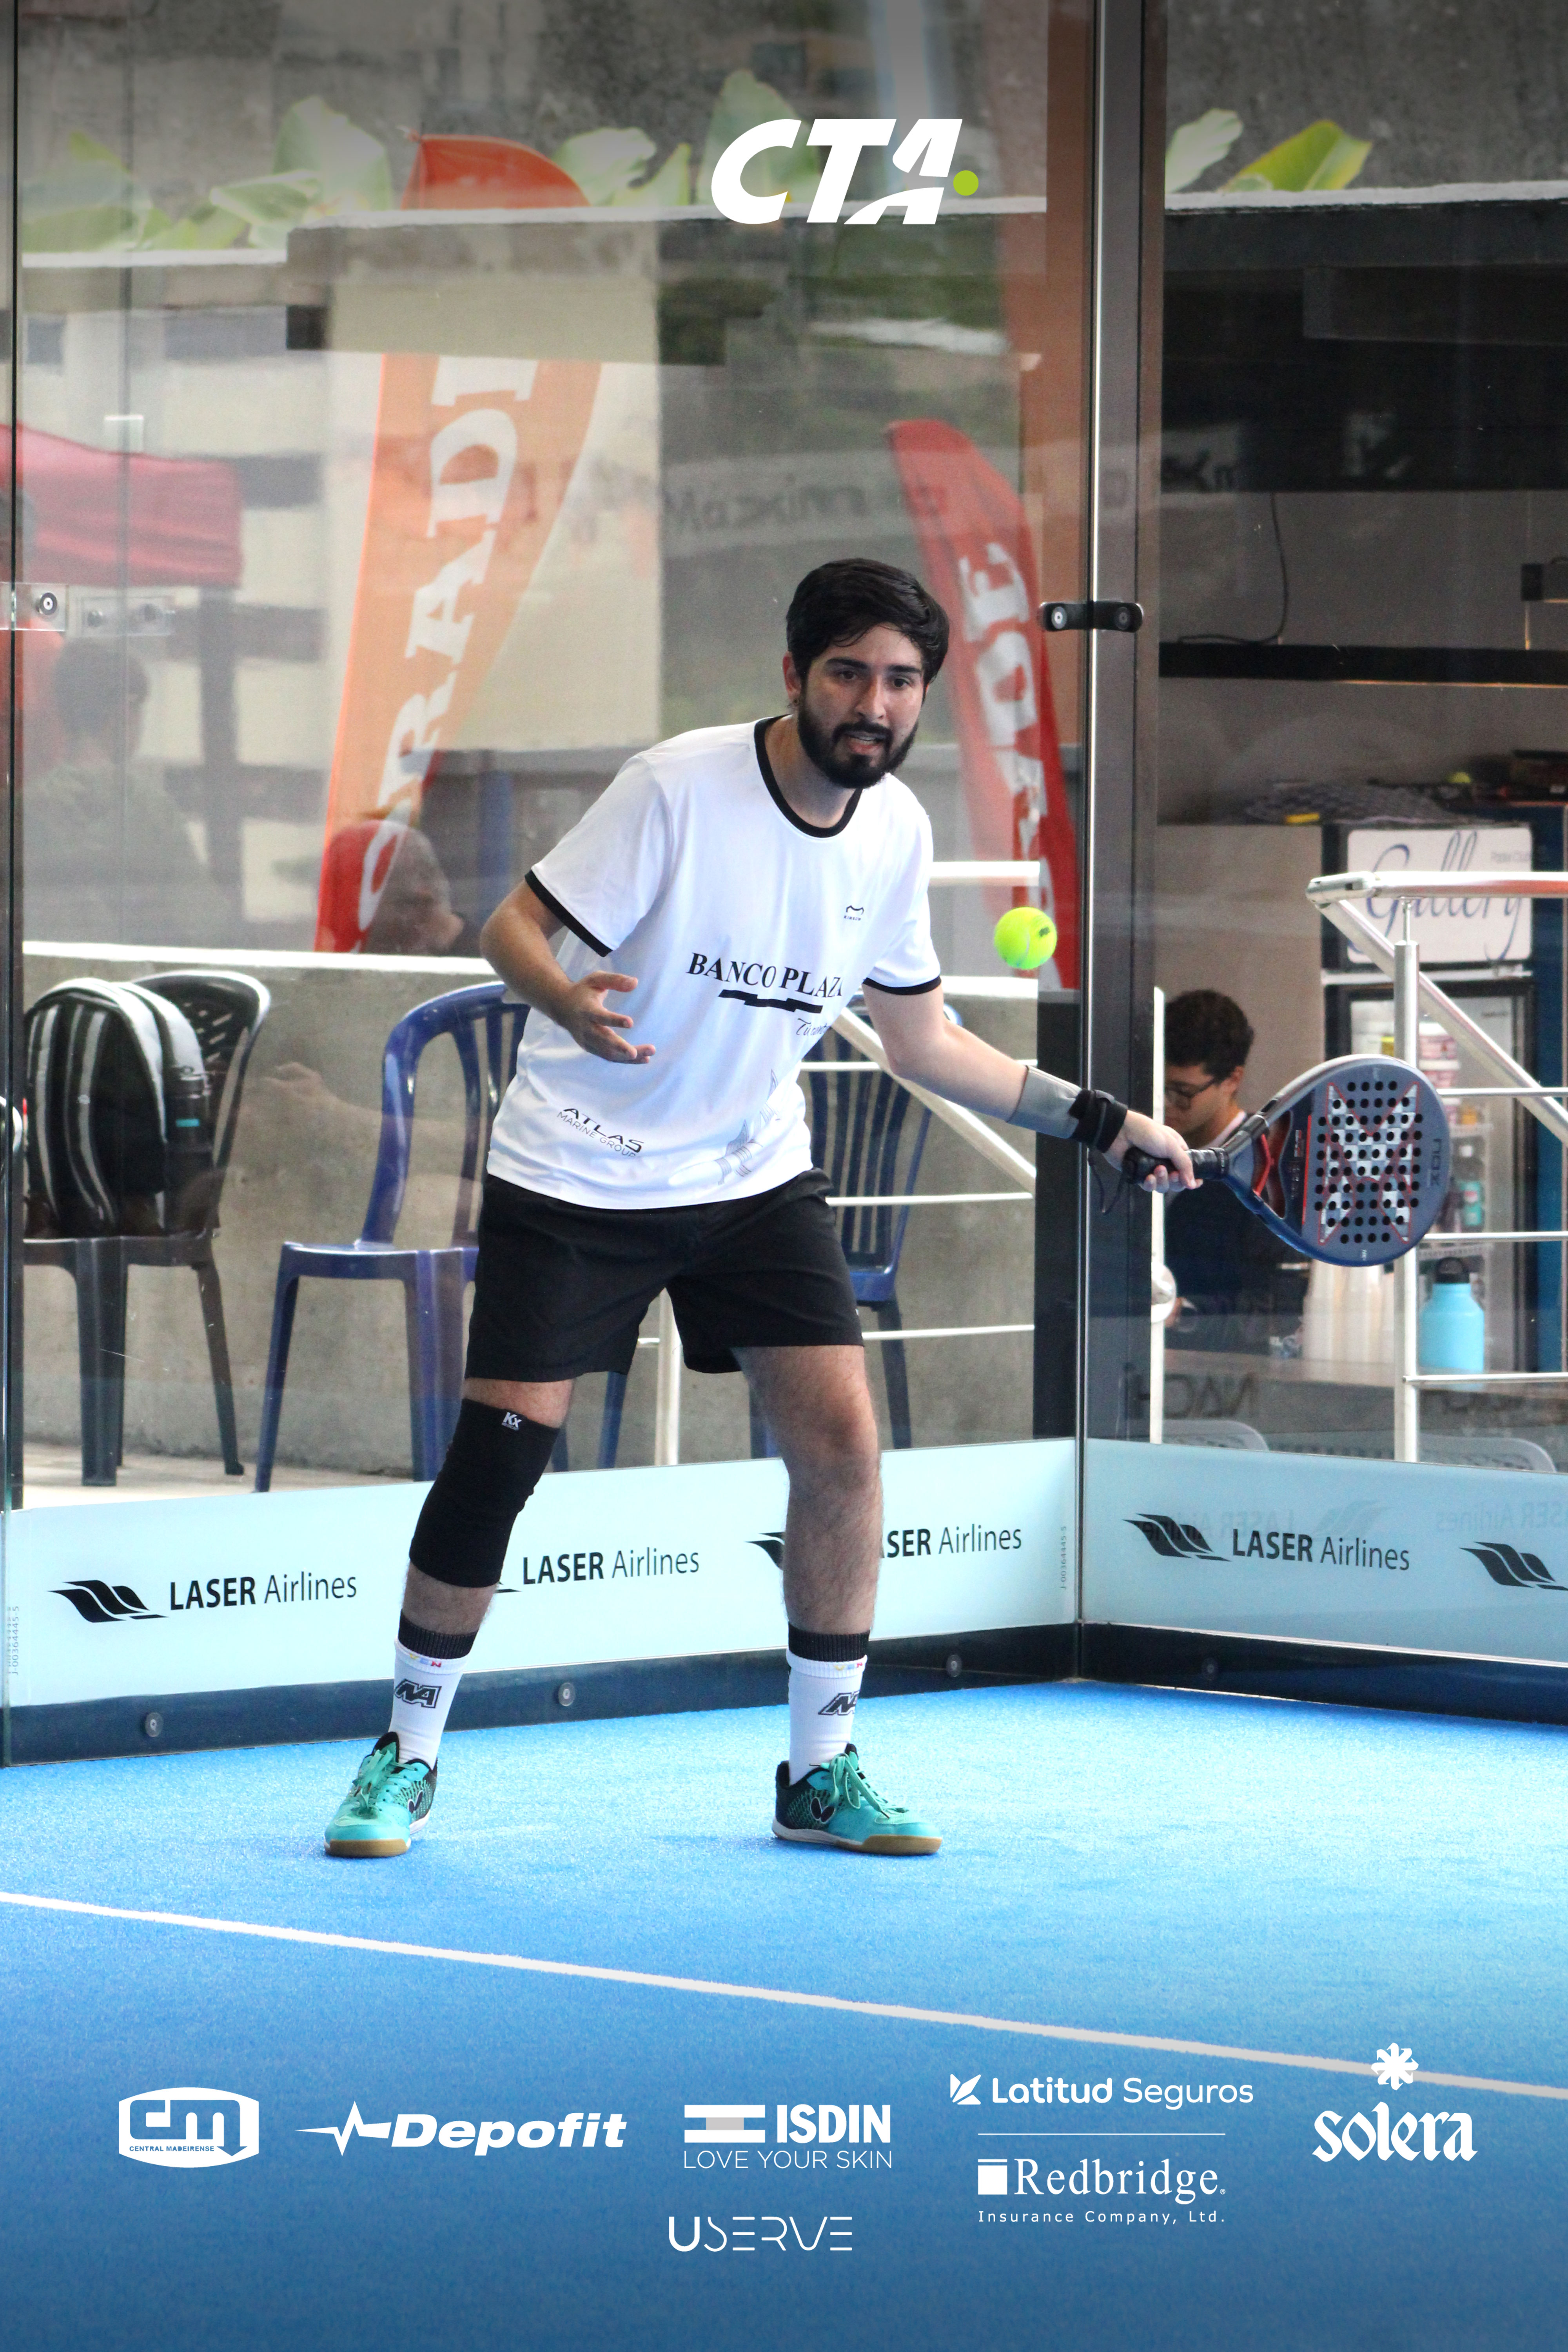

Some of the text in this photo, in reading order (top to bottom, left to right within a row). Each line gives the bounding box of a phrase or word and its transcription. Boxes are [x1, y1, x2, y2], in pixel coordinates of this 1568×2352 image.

[686, 952, 777, 988] BANCO
[557, 1111, 597, 1138] MARINE
[563, 1108, 644, 1153] ATLAS
[884, 1523, 1022, 1558] SER Airlines
[1233, 1529, 1410, 1571] LASER Airlines
[523, 1547, 699, 1584] LASER Airlines
[170, 1571, 357, 1610] LASER Airlines
